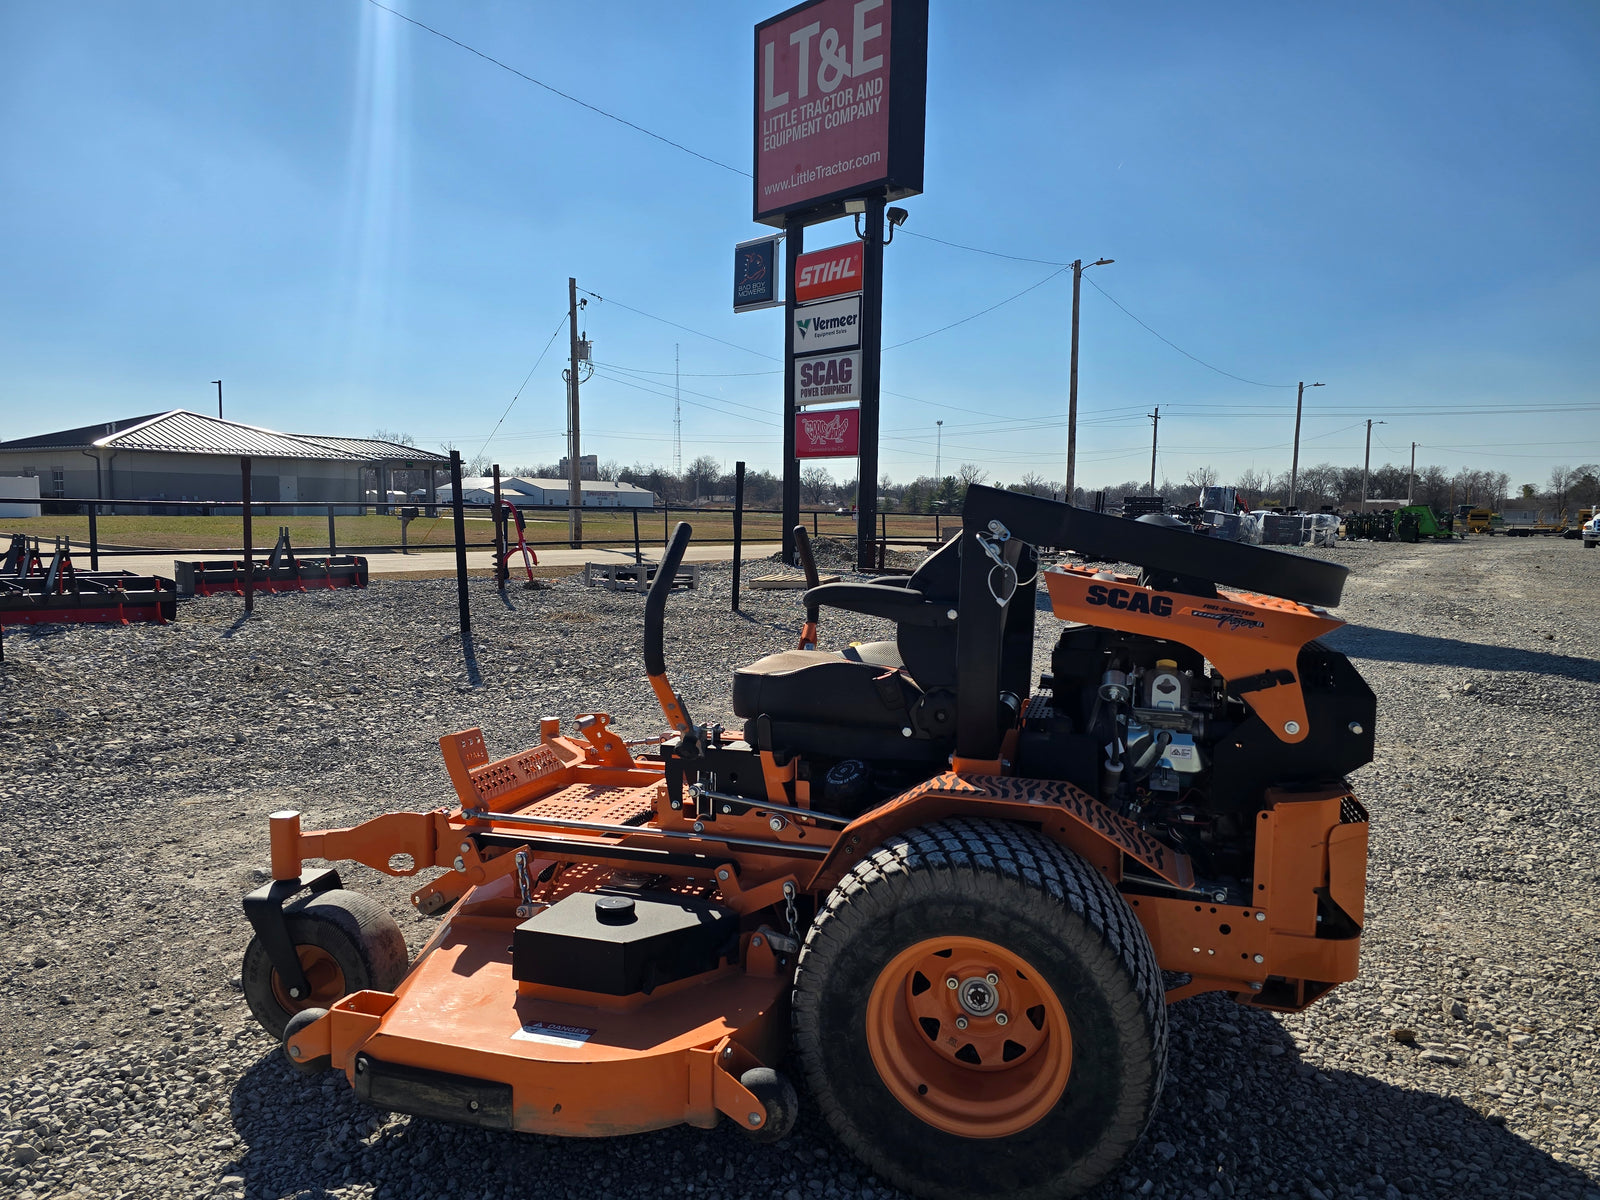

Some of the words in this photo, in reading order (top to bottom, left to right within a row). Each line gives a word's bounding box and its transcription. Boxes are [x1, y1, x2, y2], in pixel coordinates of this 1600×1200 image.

[764, 0, 883, 113] LT&E
[763, 108, 798, 136] LITTLE
[800, 87, 853, 121] TRACTOR
[856, 77, 883, 101] AND
[763, 117, 822, 152] EQUIPMENT
[824, 96, 882, 130] COMPANY
[764, 151, 881, 195] www.LittleTractor.com
[799, 257, 855, 288] STIHL
[813, 314, 857, 331] Vermeer
[800, 357, 853, 387] SCAG
[801, 386, 819, 398] POWER
[820, 383, 852, 396] EQUIPMENT
[1086, 585, 1173, 617] SCAG
[547, 1023, 589, 1034] DANGER
